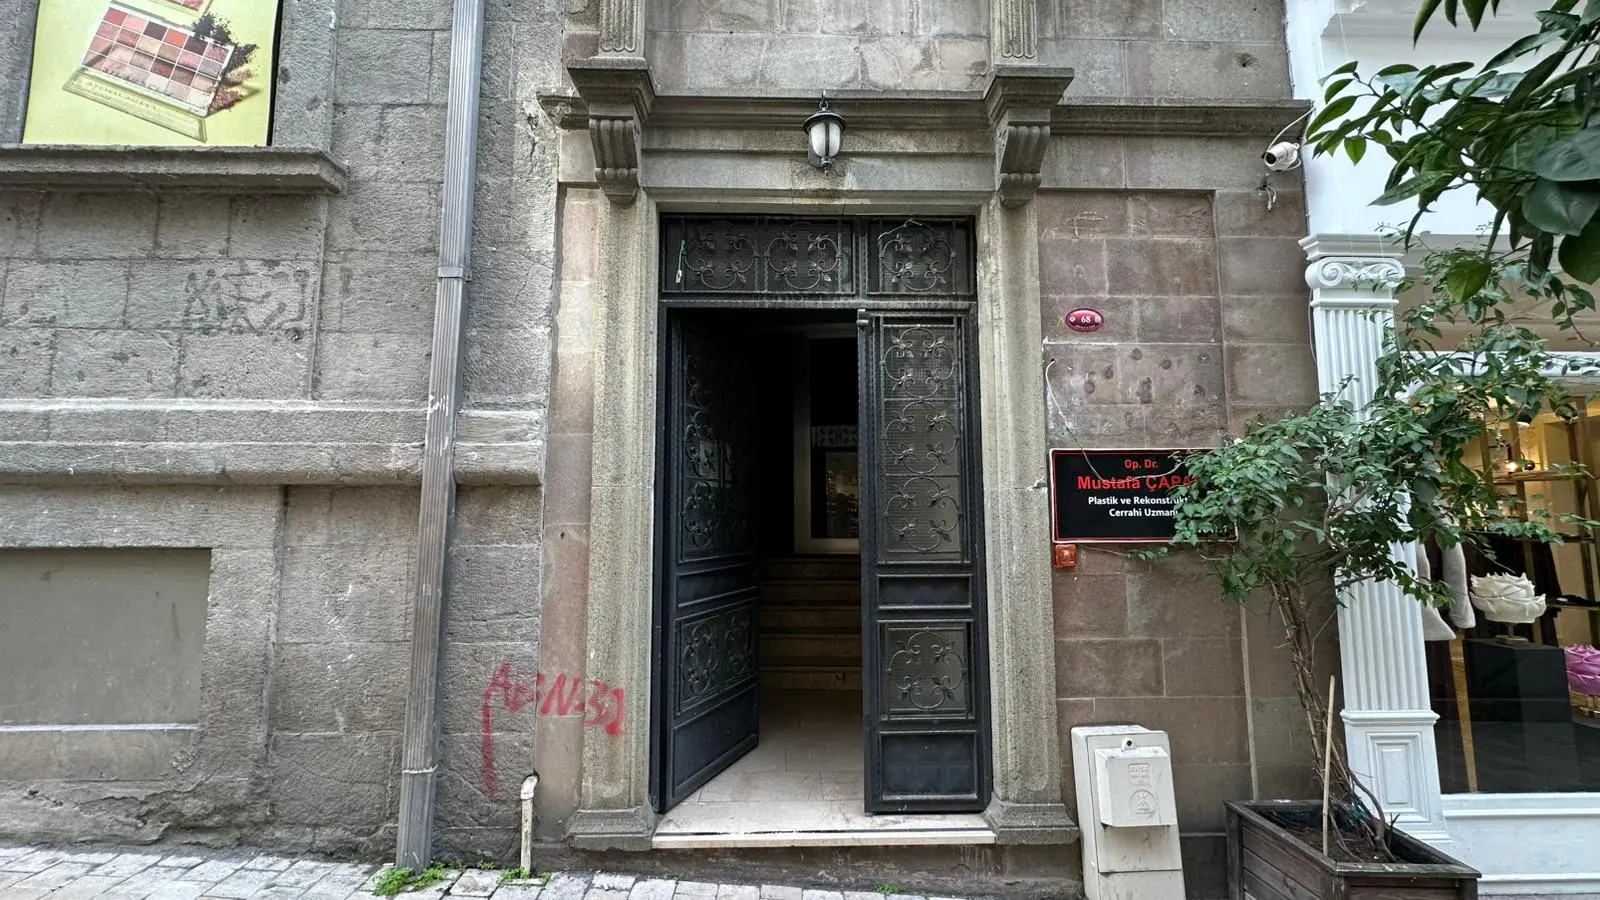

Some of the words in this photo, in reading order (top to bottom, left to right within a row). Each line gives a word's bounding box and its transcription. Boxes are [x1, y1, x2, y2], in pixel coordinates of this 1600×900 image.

[1124, 459, 1142, 471] Op.
[1144, 459, 1159, 469] Dr.
[1077, 475, 1141, 490] Mustafa
[1088, 496, 1119, 505] Plastik
[1109, 508, 1143, 517] Cerrahi
